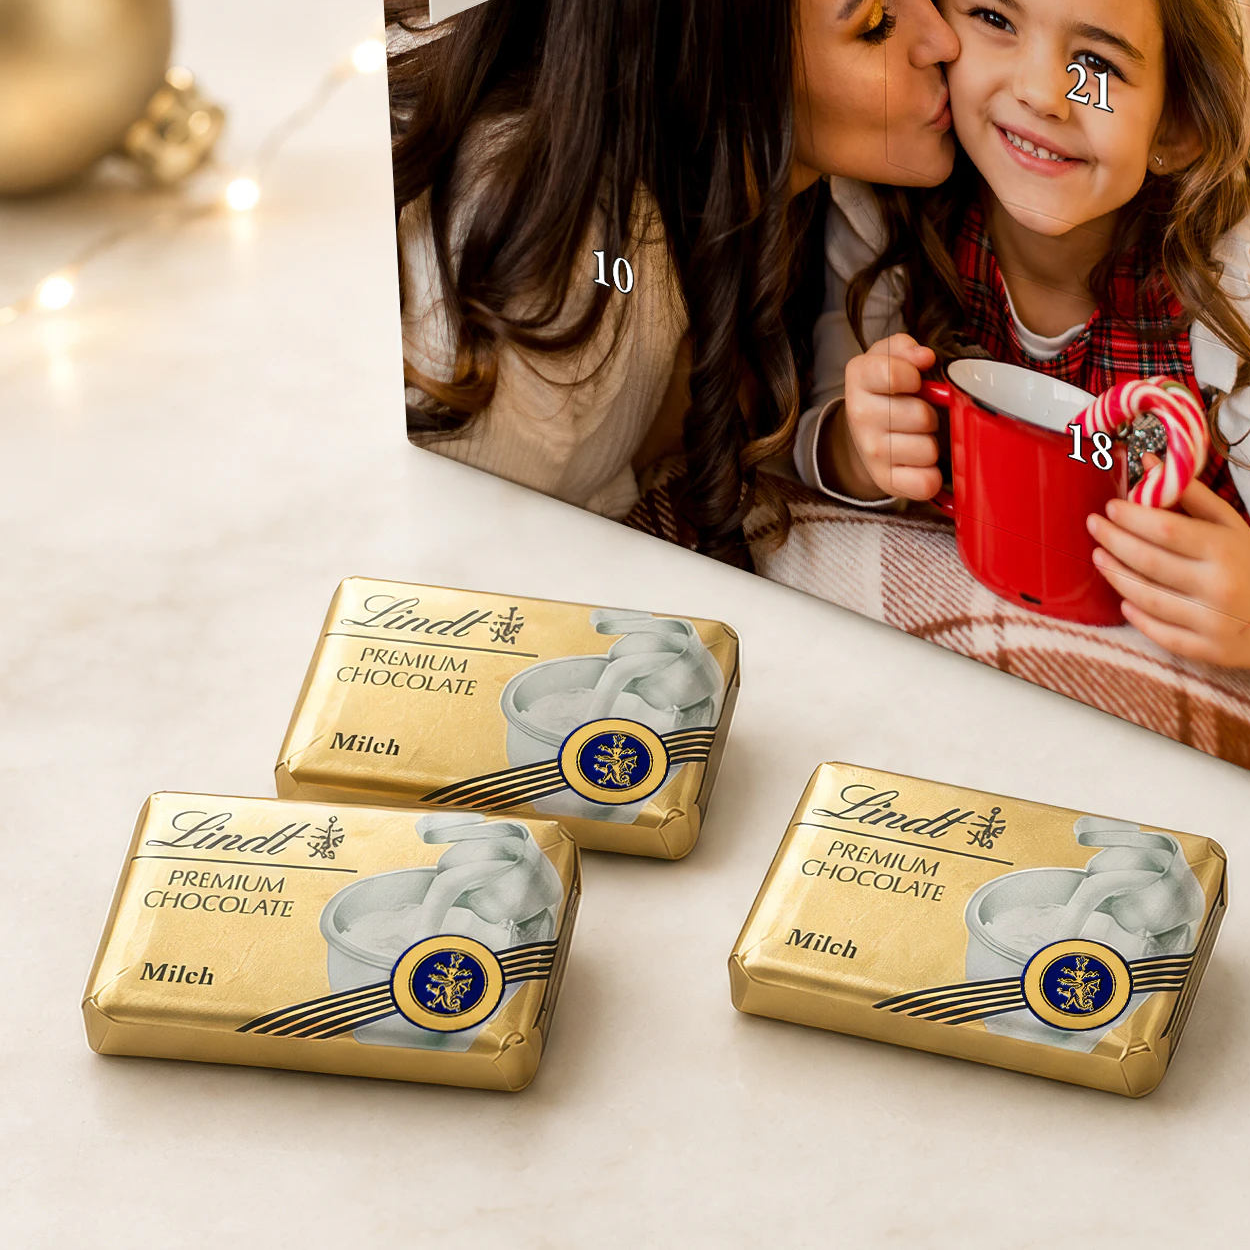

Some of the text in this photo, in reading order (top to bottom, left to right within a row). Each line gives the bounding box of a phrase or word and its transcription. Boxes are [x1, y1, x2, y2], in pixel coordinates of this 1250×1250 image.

[1066, 63, 1113, 113] 21
[593, 250, 634, 294] 10
[1067, 423, 1114, 471] 18
[340, 594, 493, 638] Lindt
[360, 647, 468, 673] PREMIUM
[336, 666, 478, 696] CHOCOLATE
[330, 732, 401, 756] Milch
[812, 784, 975, 838] Lindt
[146, 810, 311, 855] Lindt
[827, 840, 940, 877] PREMIUM
[168, 870, 285, 894] PREMIUM
[802, 859, 946, 902] CHOCOLATE
[144, 890, 294, 918] CHOCOLATE
[785, 928, 858, 959] Milch
[140, 963, 214, 986] Milch
